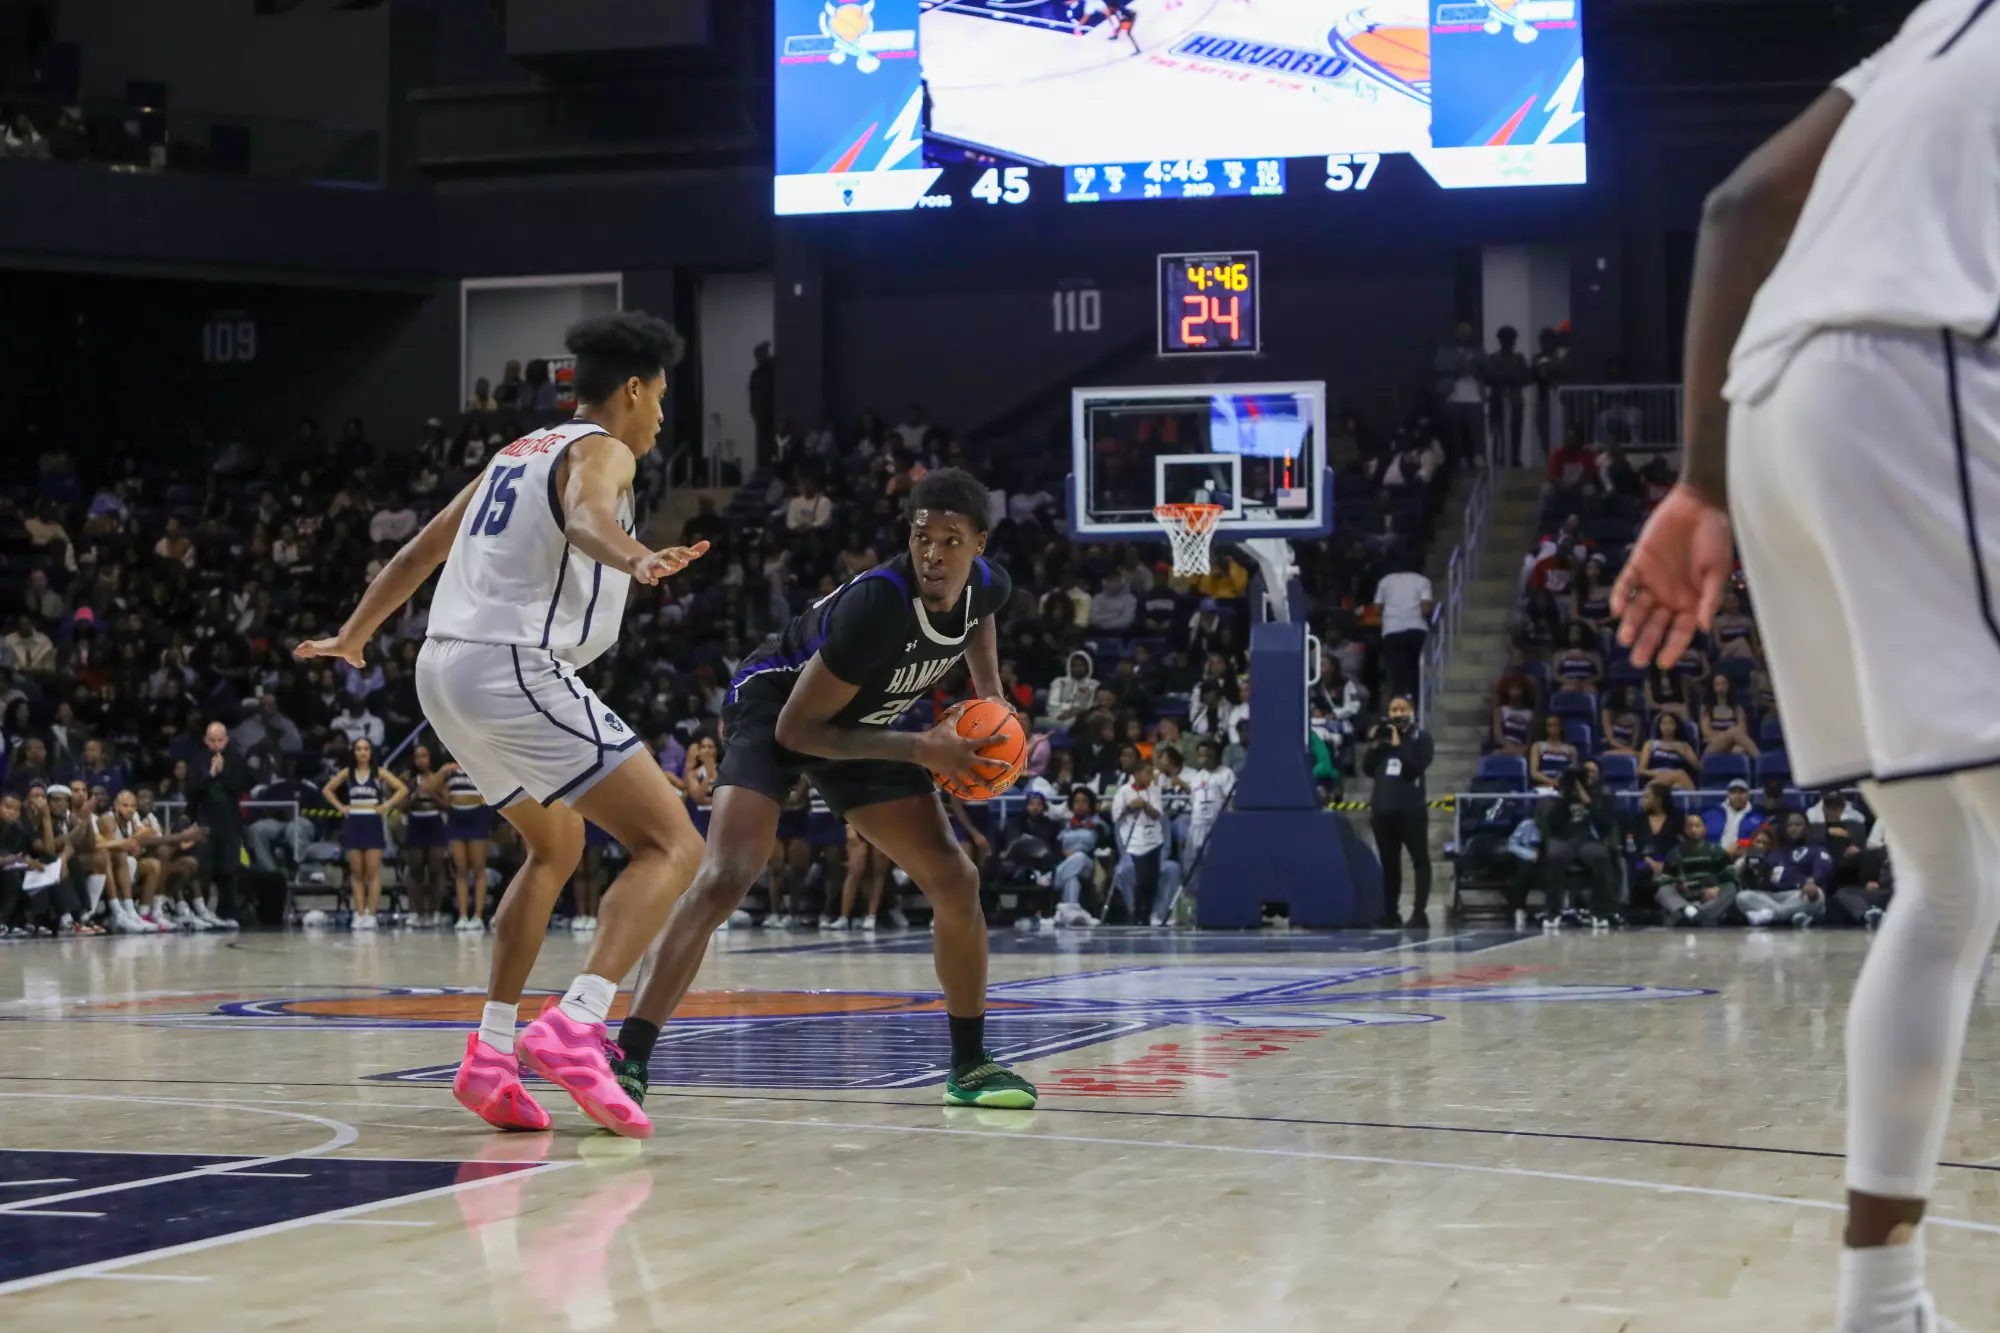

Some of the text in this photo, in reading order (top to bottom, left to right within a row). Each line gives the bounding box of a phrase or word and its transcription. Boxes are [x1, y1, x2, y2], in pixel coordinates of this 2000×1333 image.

[1184, 36, 1350, 79] HOWARD
[971, 167, 1030, 204] 45
[1144, 159, 1208, 182] 4:46
[1325, 153, 1380, 191] 57
[919, 195, 952, 208] POSS
[1188, 263, 1248, 291] 4:46
[1053, 290, 1101, 332] 110
[1181, 295, 1239, 344] 24
[203, 321, 256, 362] 109
[469, 464, 527, 537] 15
[884, 649, 966, 694] HAMP
